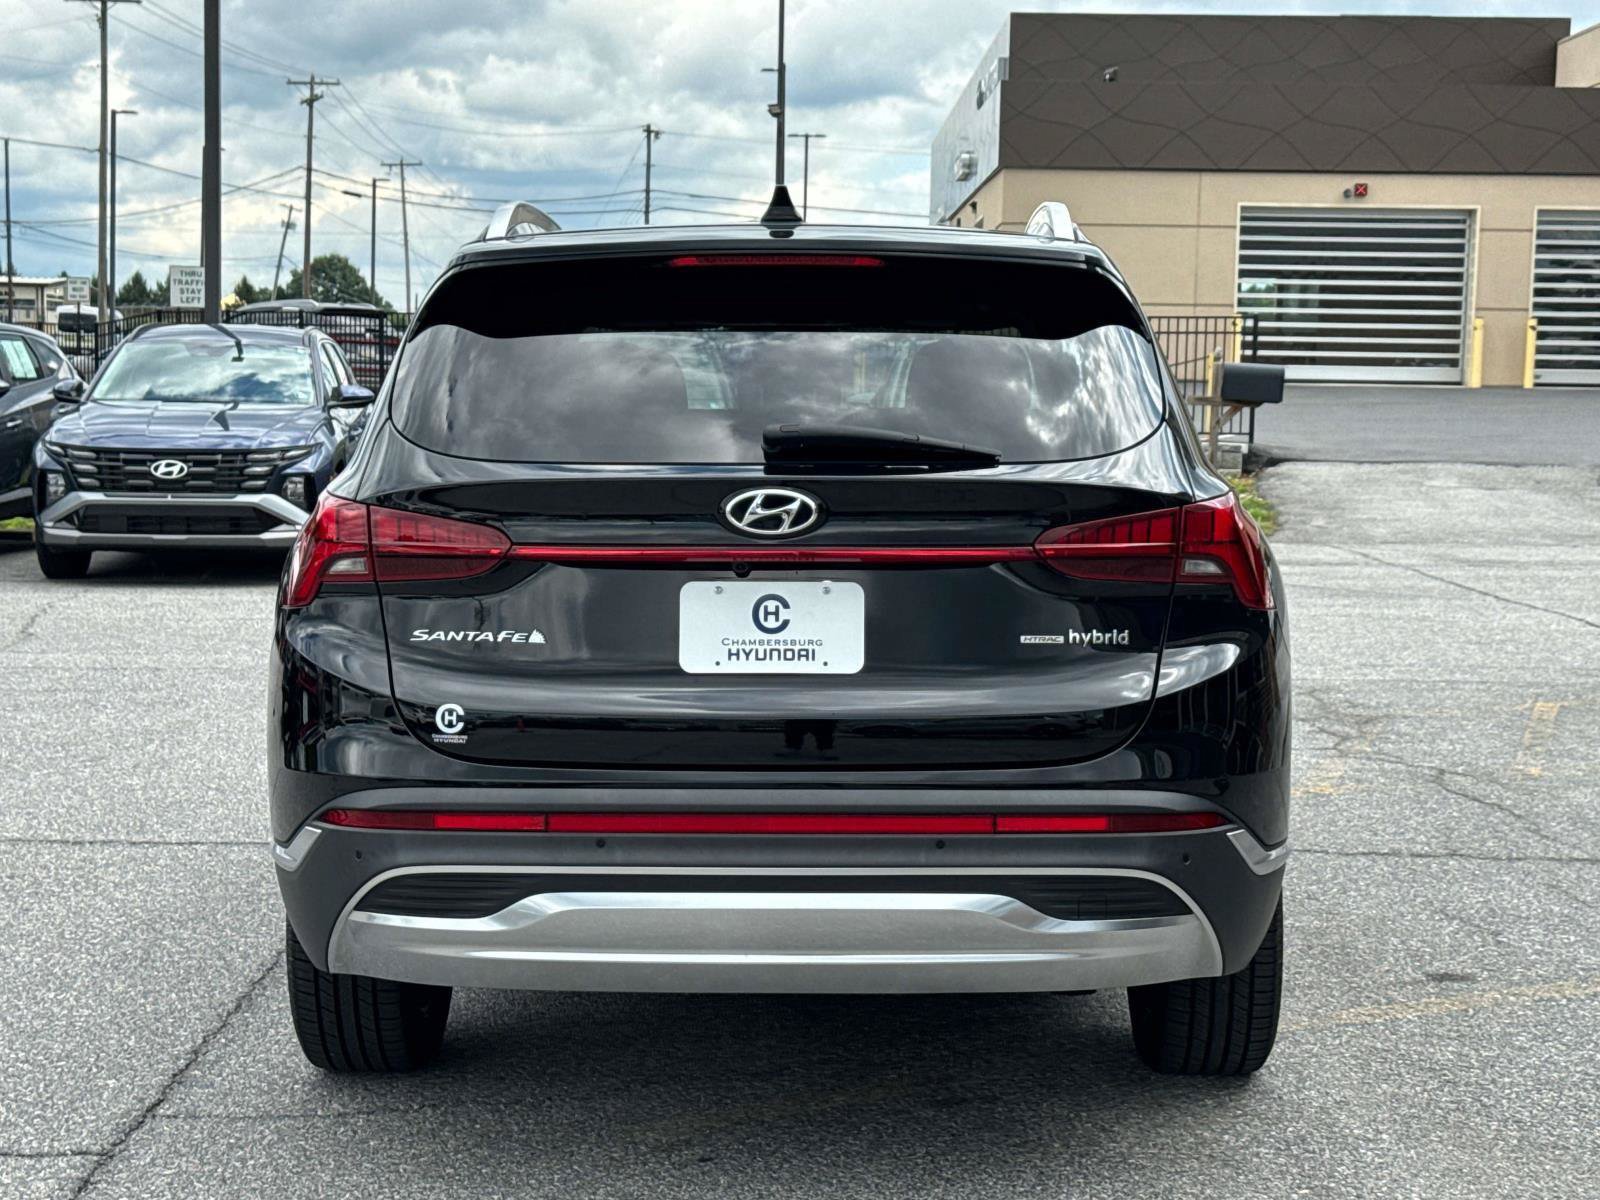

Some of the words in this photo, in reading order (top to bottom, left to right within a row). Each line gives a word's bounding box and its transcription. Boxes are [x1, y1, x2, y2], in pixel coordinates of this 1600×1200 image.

[180, 270, 203, 278] THRU
[180, 287, 202, 295] STAY
[180, 296, 201, 304] LEFT
[721, 637, 823, 647] CHAMBERSBURG
[1068, 629, 1129, 648] hybrid
[727, 648, 816, 661] HYUNDAI
